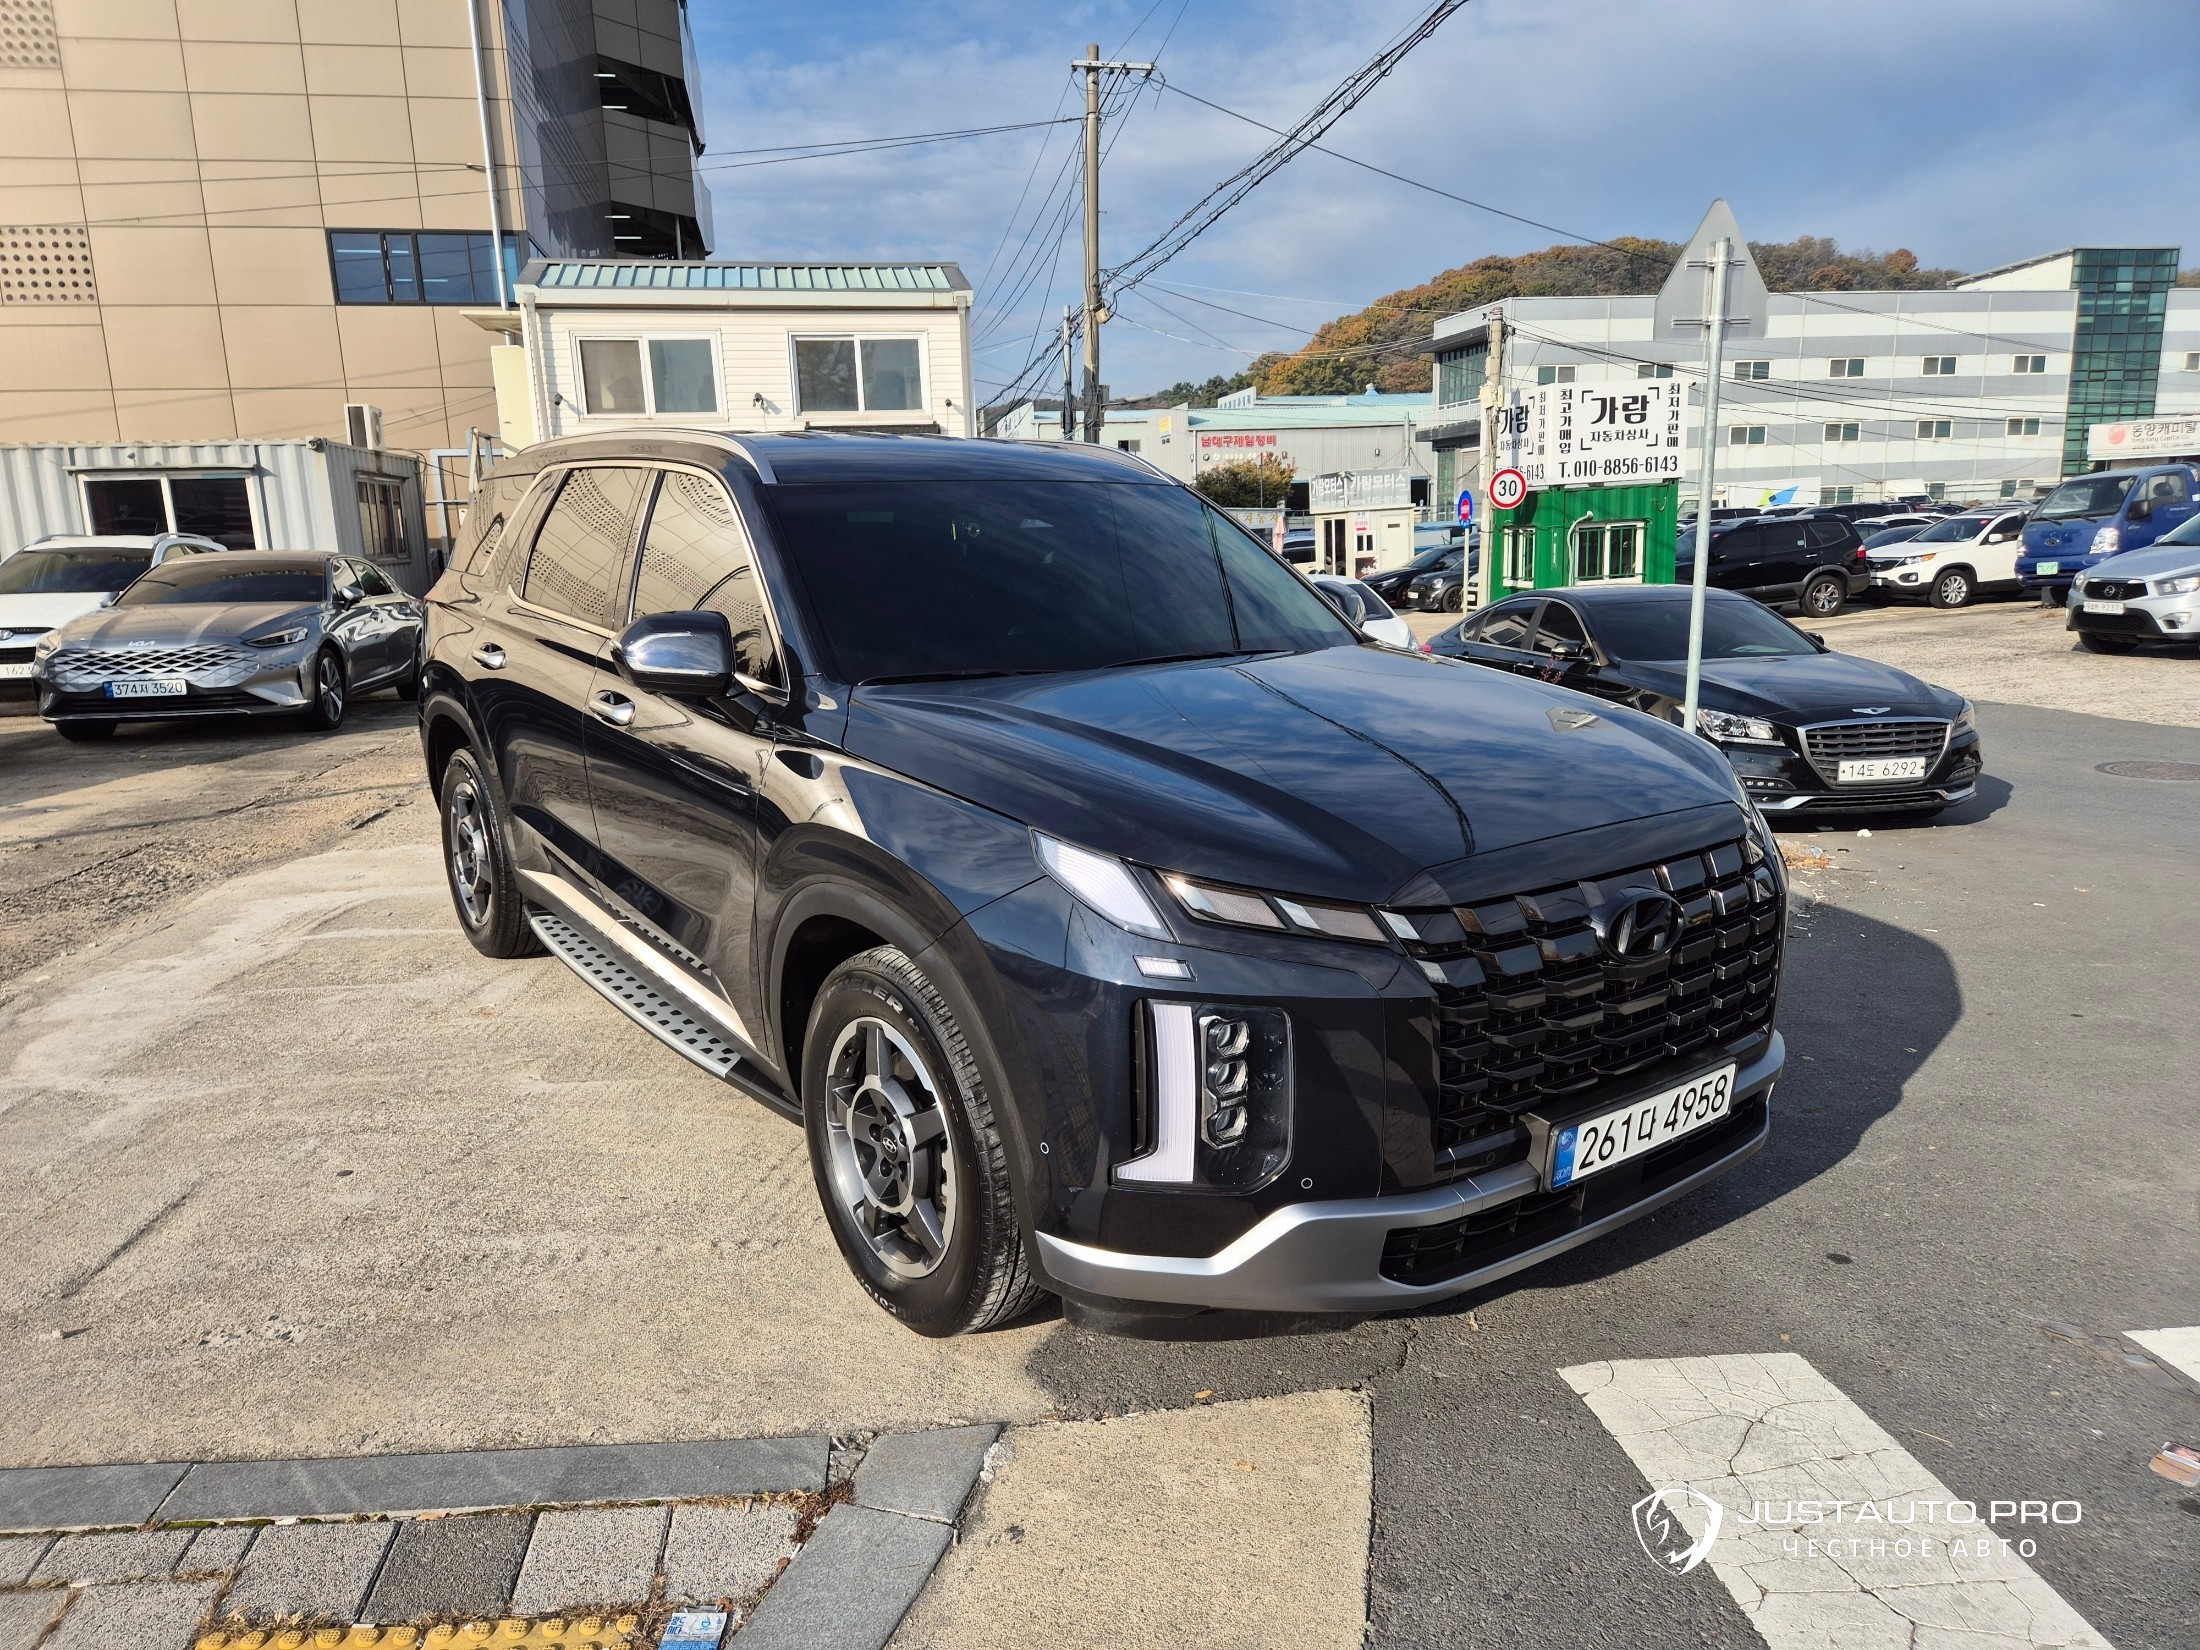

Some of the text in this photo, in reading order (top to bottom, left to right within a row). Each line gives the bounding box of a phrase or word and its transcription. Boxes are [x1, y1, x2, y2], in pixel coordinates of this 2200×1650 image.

[1500, 404, 1530, 435] 가람
[1559, 388, 1573, 455] 최고가매입
[1590, 394, 1650, 425] 가람
[1666, 382, 1680, 448] 최저가판매
[1590, 428, 1649, 442] 자동차상사
[1349, 473, 1407, 491] 가람모터스
[1498, 480, 1517, 496] 30
[151, 682, 183, 694] 3520
[1882, 761, 1917, 776] 6292
[1663, 1074, 1728, 1132] 4958
